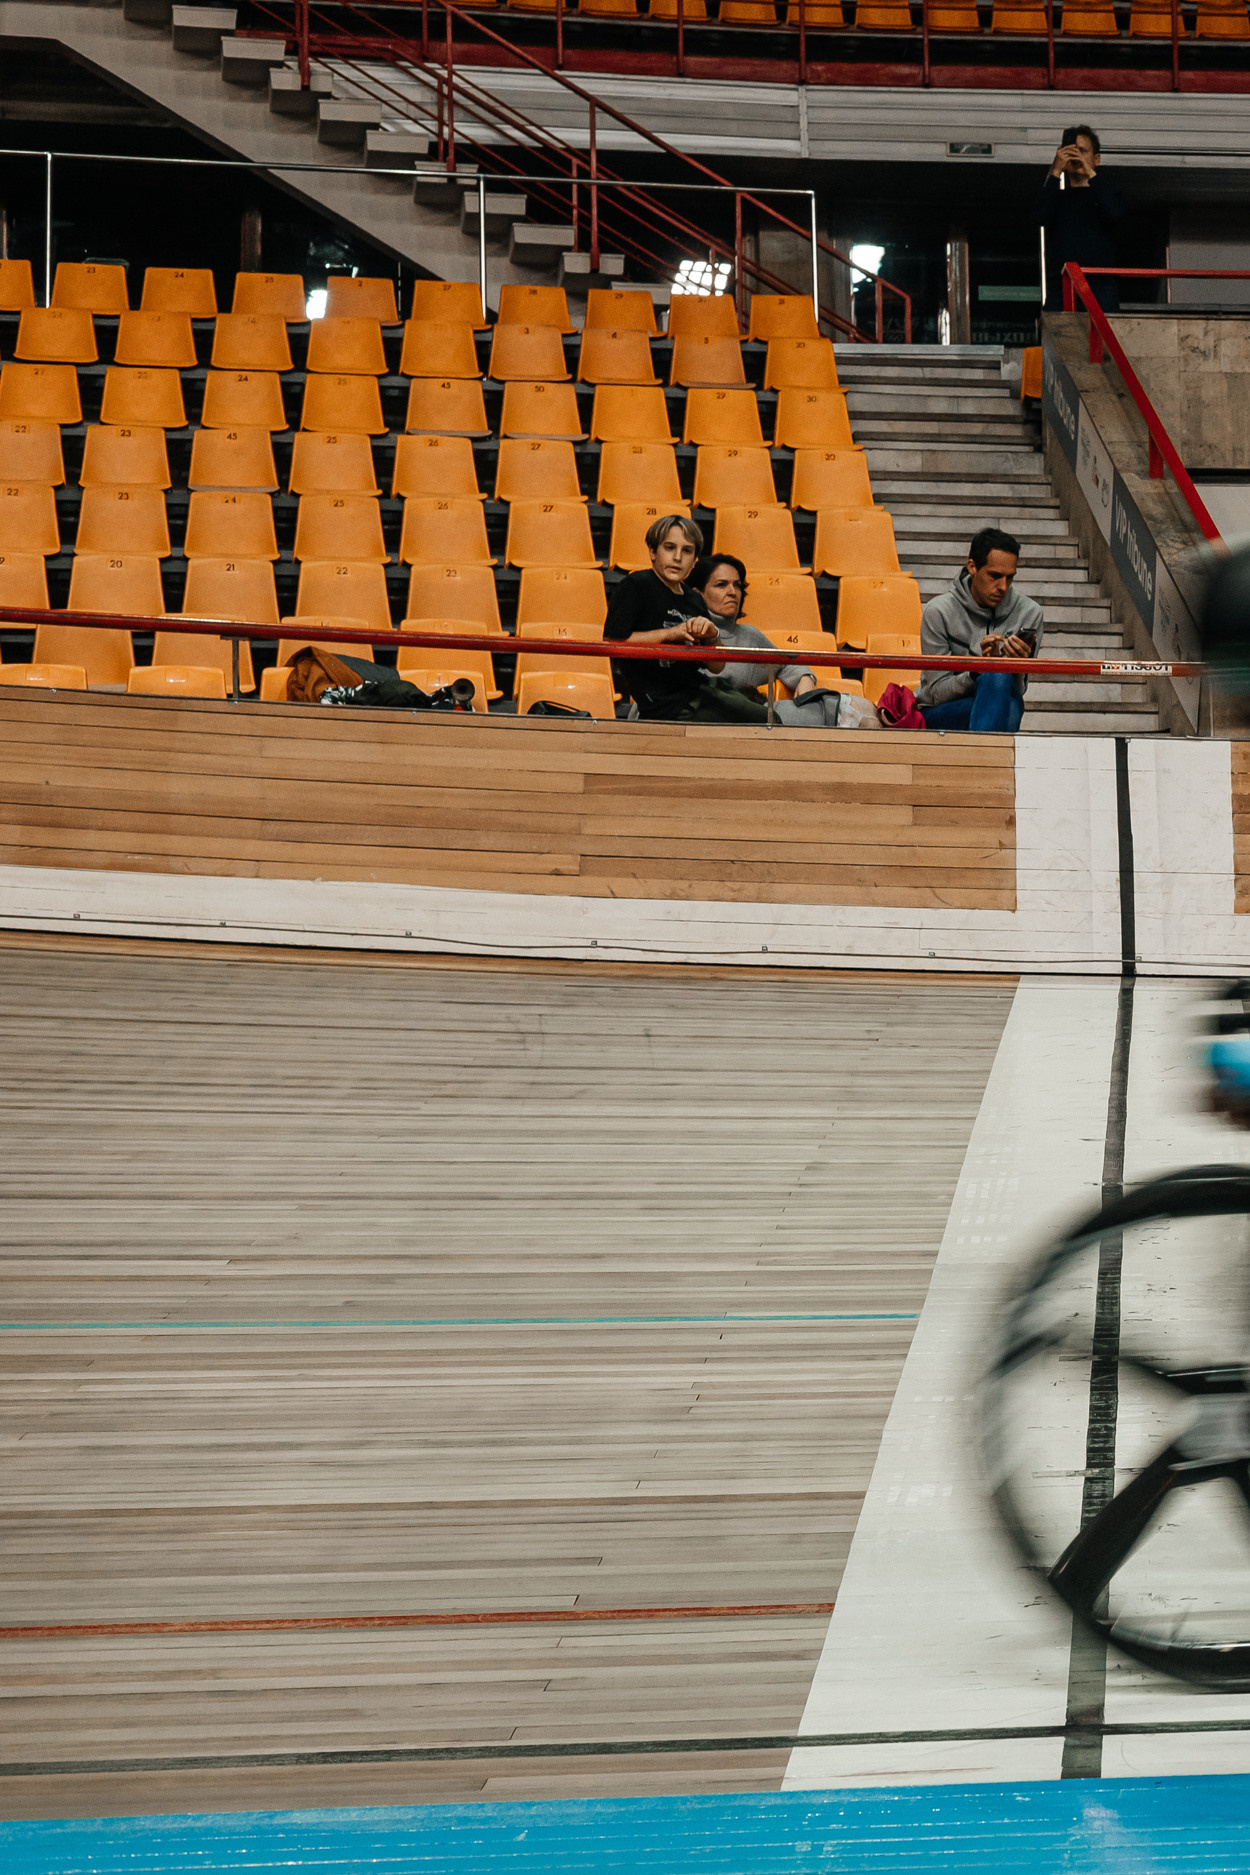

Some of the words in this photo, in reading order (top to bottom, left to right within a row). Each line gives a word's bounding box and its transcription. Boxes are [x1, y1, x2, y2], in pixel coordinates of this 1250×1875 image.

[807, 395, 817, 403] 30
[15, 425, 26, 433] 22
[120, 429, 131, 437] 23
[226, 432, 237, 440] 45
[326, 436, 337, 444] 25
[428, 439, 438, 447] 26
[530, 443, 541, 451] 27
[728, 449, 738, 457] 29
[7, 488, 18, 497] 22
[118, 492, 129, 500] 23
[333, 499, 344, 507] 25
[543, 505, 553, 513] 27
[646, 507, 656, 515] 28
[747, 511, 758, 519] 29
[1115, 494, 1127, 544] VIP
[1126, 519, 1153, 601] tribune
[110, 560, 122, 569] 20
[226, 564, 234, 572] 21
[336, 567, 348, 575] 22
[446, 569, 457, 578] 23
[787, 635, 799, 644] 46
